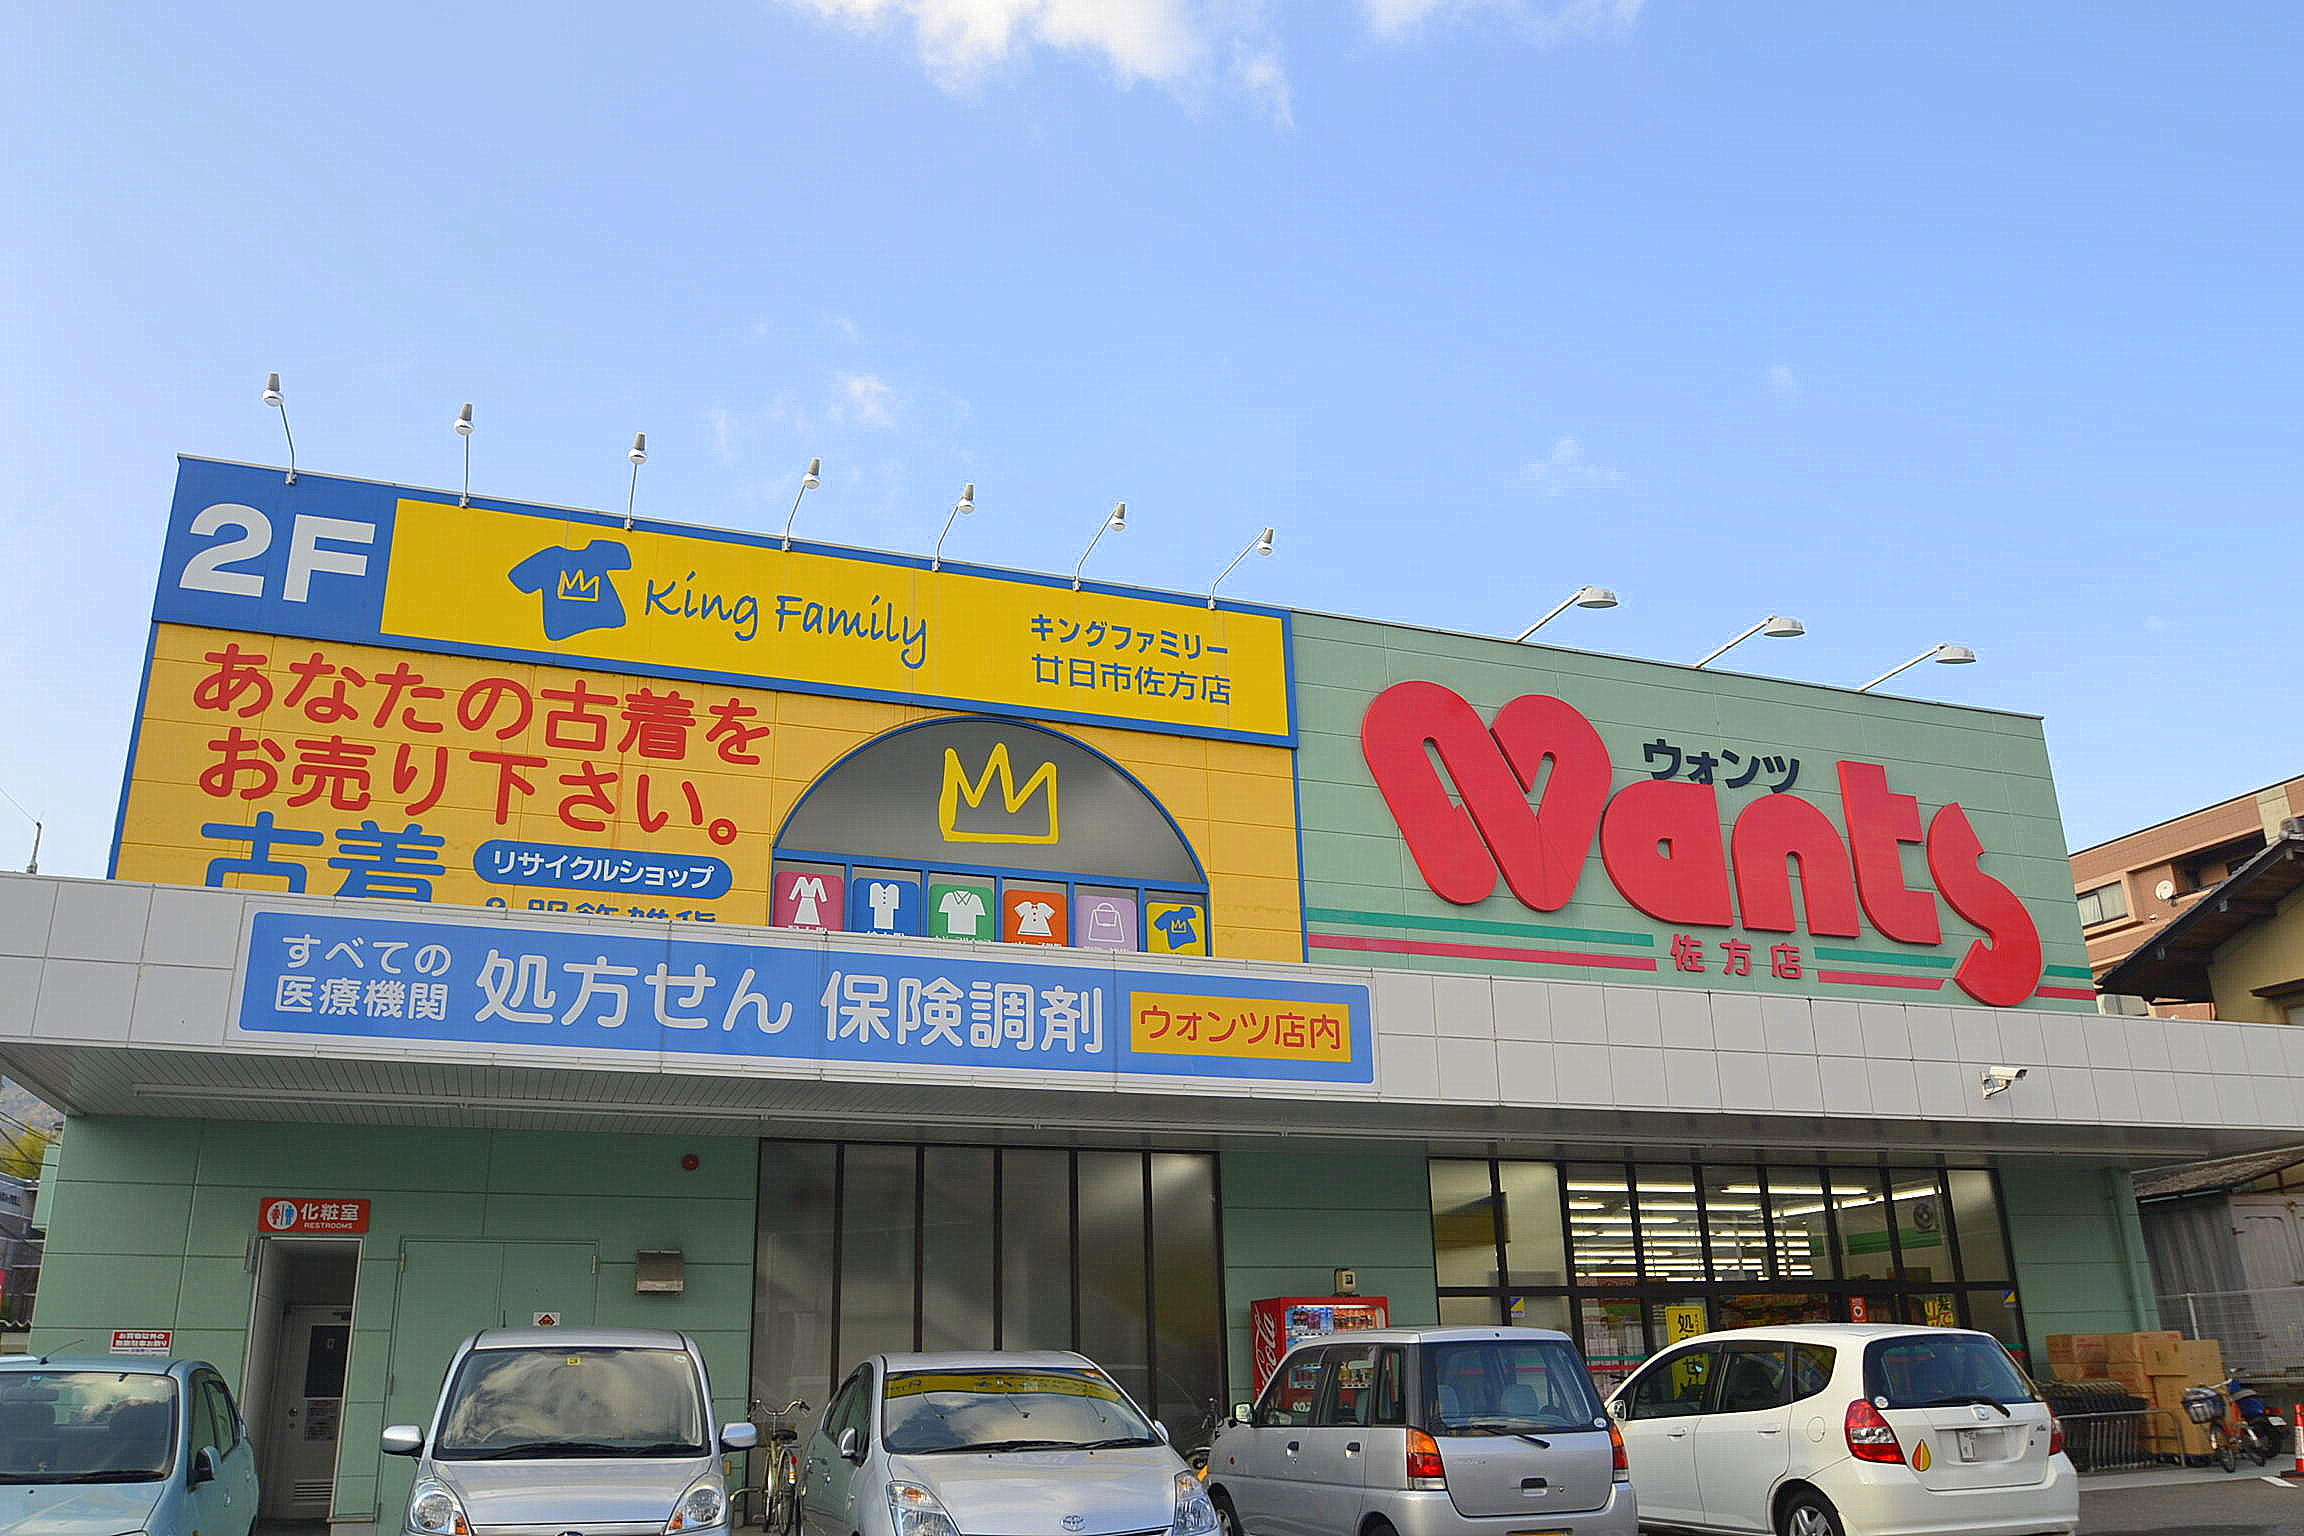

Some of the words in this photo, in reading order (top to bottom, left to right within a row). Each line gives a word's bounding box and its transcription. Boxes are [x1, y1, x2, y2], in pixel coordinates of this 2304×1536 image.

[179, 504, 376, 604] 2F
[644, 570, 758, 641] King
[776, 595, 927, 669] Family
[1031, 613, 1229, 659] キングファミリー
[193, 642, 770, 765] あなたの古着を
[1031, 654, 1231, 706] 廿日市佐方店
[199, 726, 738, 846] お売り下さい。
[493, 850, 716, 889] リサイクルショップ
[1360, 680, 2043, 1007] Wants
[281, 933, 453, 977] すべての
[1670, 933, 1802, 980] 佐方店
[274, 975, 449, 1023] 医療機関
[474, 948, 794, 1035] 処方せん
[819, 968, 1104, 1054] 保険調剤
[300, 1202, 360, 1221] 化粧室
